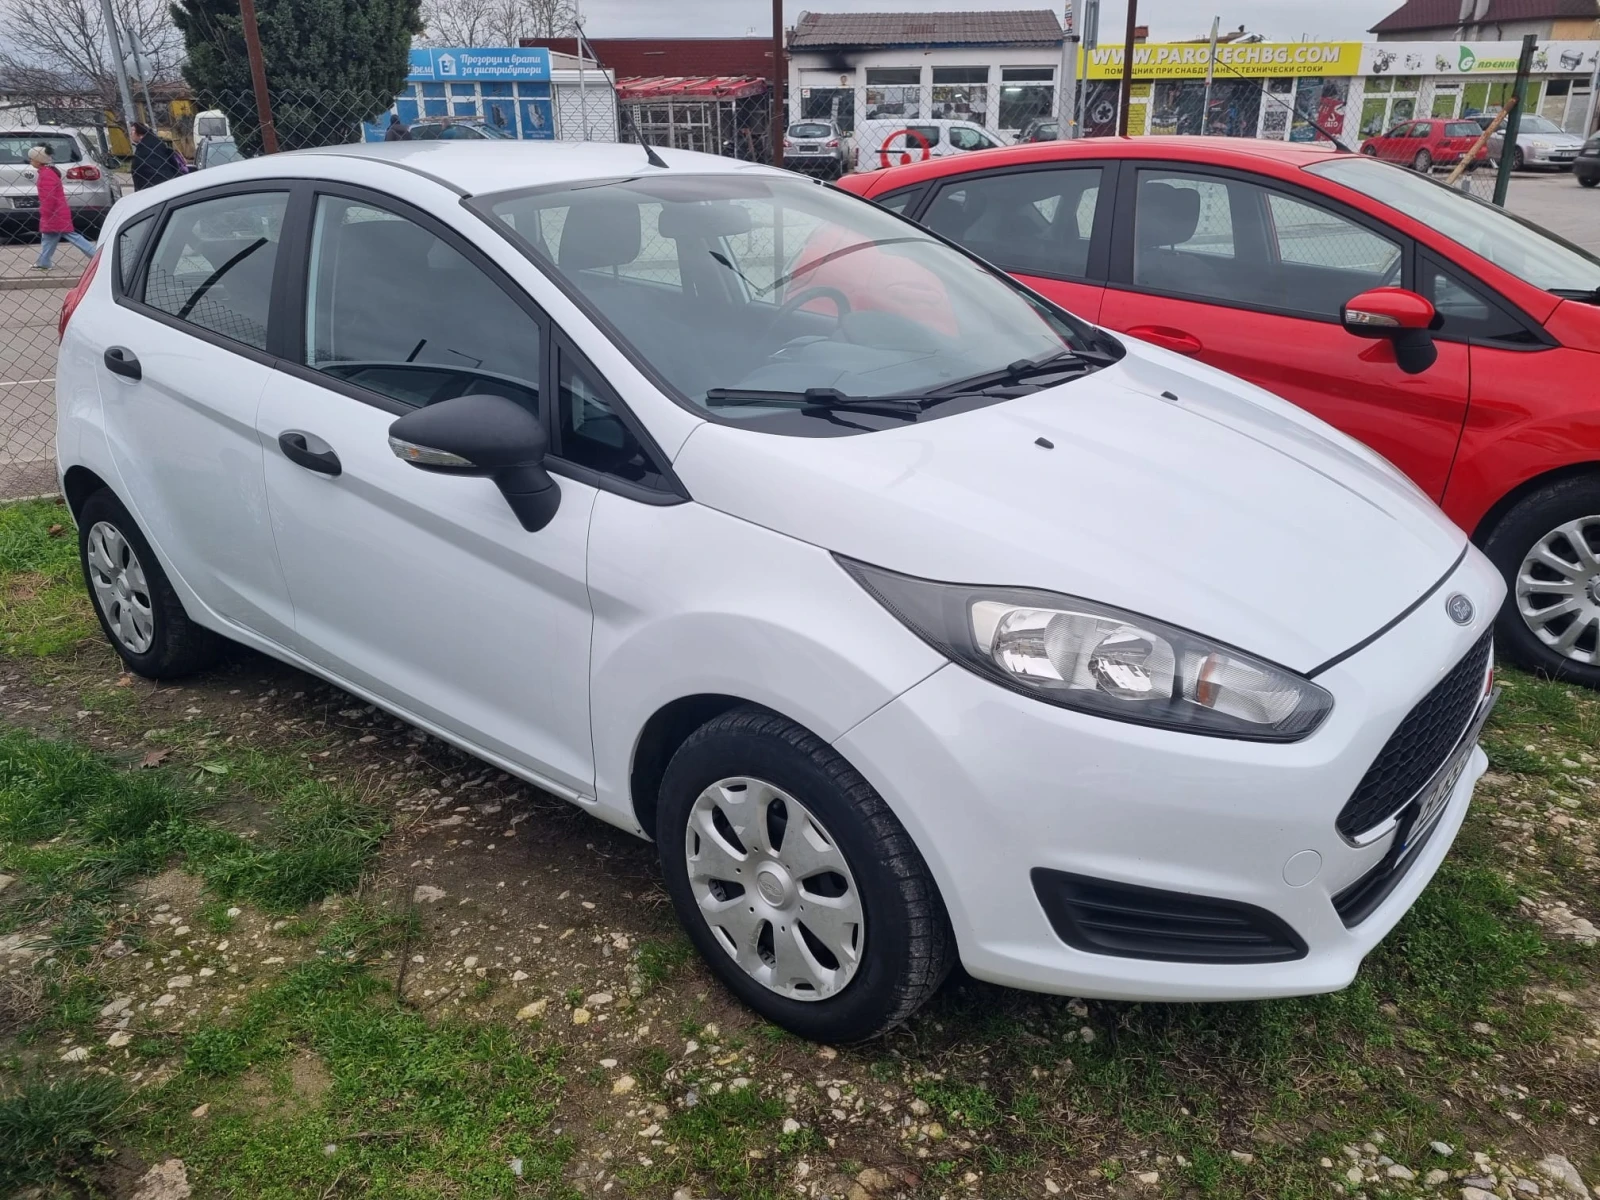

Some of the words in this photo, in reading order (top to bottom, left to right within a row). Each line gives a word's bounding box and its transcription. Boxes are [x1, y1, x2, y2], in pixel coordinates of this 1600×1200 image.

[460, 53, 502, 65] Прозорци
[511, 54, 541, 65] врати
[1091, 46, 1340, 65] WWW.PAROTECHBG.COM
[462, 66, 472, 76] за
[473, 64, 542, 76] дистрибутори
[1105, 67, 1154, 75] ПОМЩНИК
[1175, 66, 1231, 74] СНАБДЯАНЕ
[1241, 66, 1295, 74] ТЕХНИЧЕСКИ
